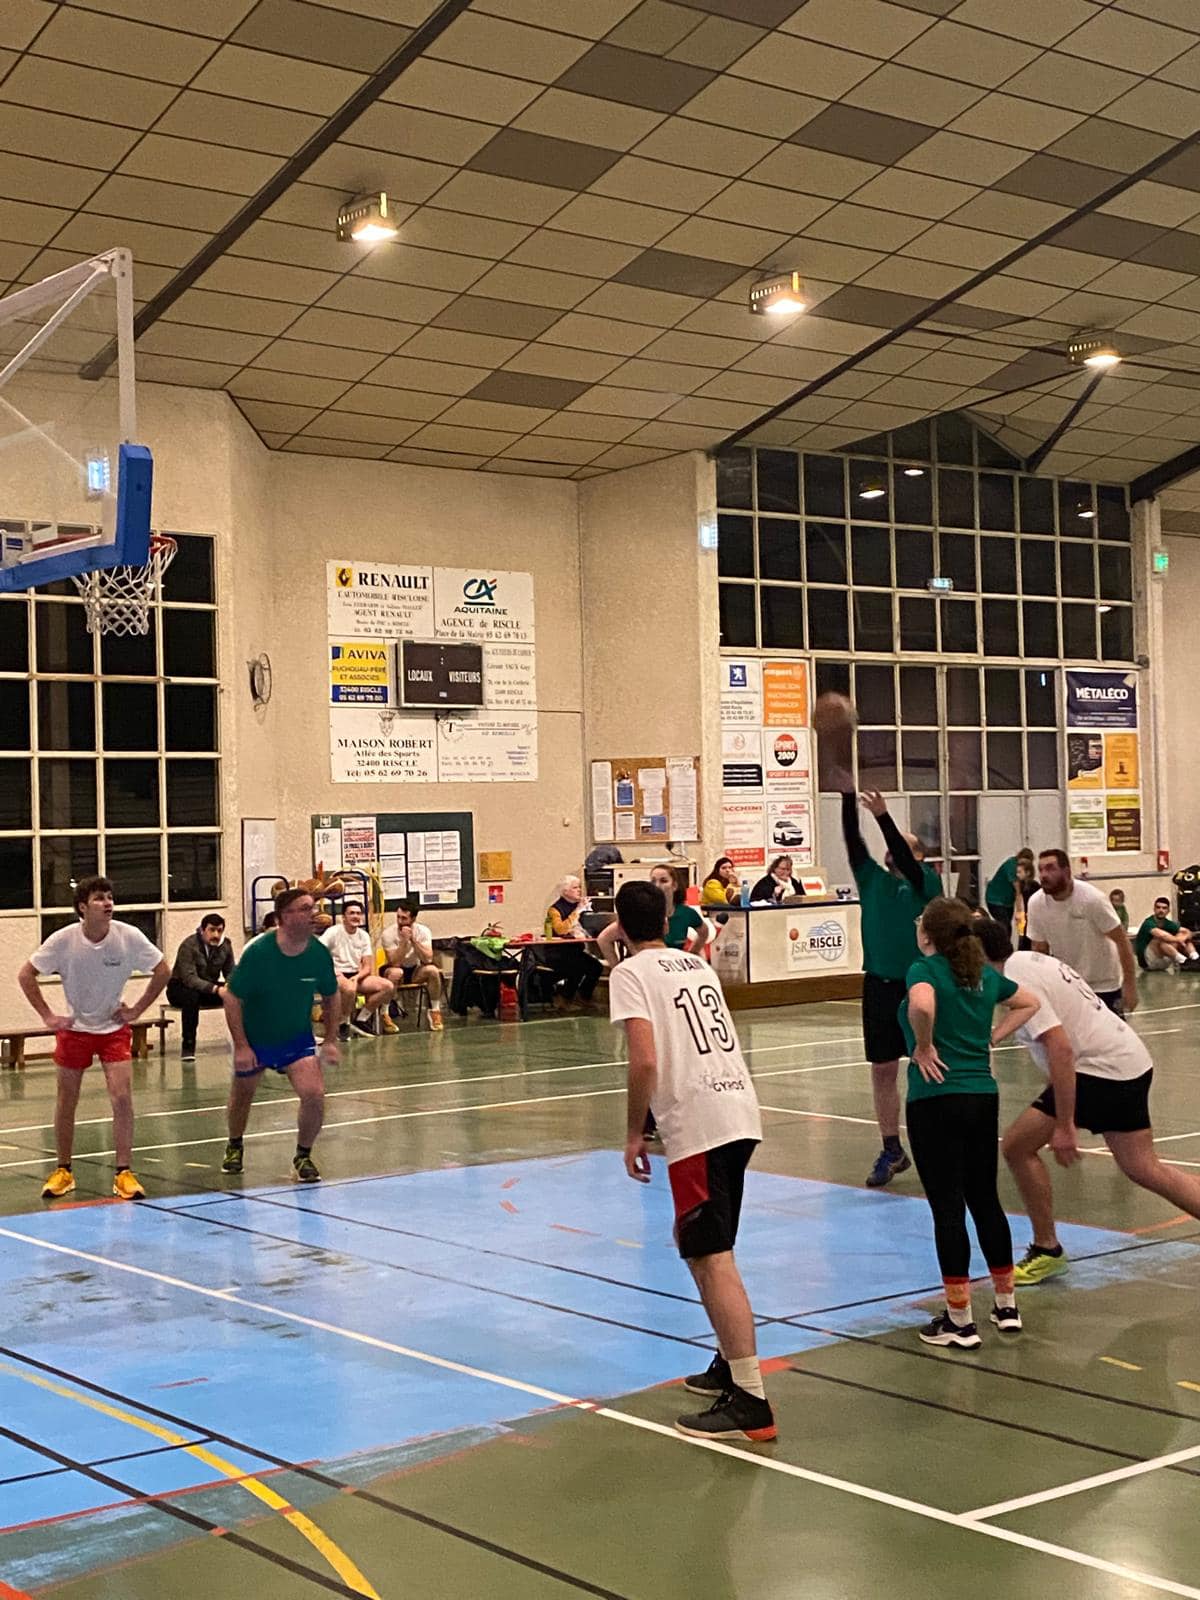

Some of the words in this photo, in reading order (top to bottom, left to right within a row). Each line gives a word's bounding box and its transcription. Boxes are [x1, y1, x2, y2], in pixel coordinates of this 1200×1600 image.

[358, 572, 430, 590] RENAULT
[354, 609, 377, 617] AGENT
[380, 610, 412, 618] RENAULT
[454, 606, 508, 615] AQUITAINE
[441, 618, 474, 628] AGENCE
[480, 620, 488, 628] de
[493, 620, 520, 629] RISCLE
[347, 650, 386, 660] AVIVA
[407, 669, 433, 682] LOCAUX
[448, 671, 480, 683] VISITEURS
[337, 738, 385, 748] MAISON
[389, 739, 434, 748] ROBERT
[394, 751, 420, 759] Sports
[777, 752, 796, 760] 2000
[810, 935, 842, 949] RISCLE
[673, 985, 735, 1055] 13
[713, 1080, 745, 1092] GYROS
